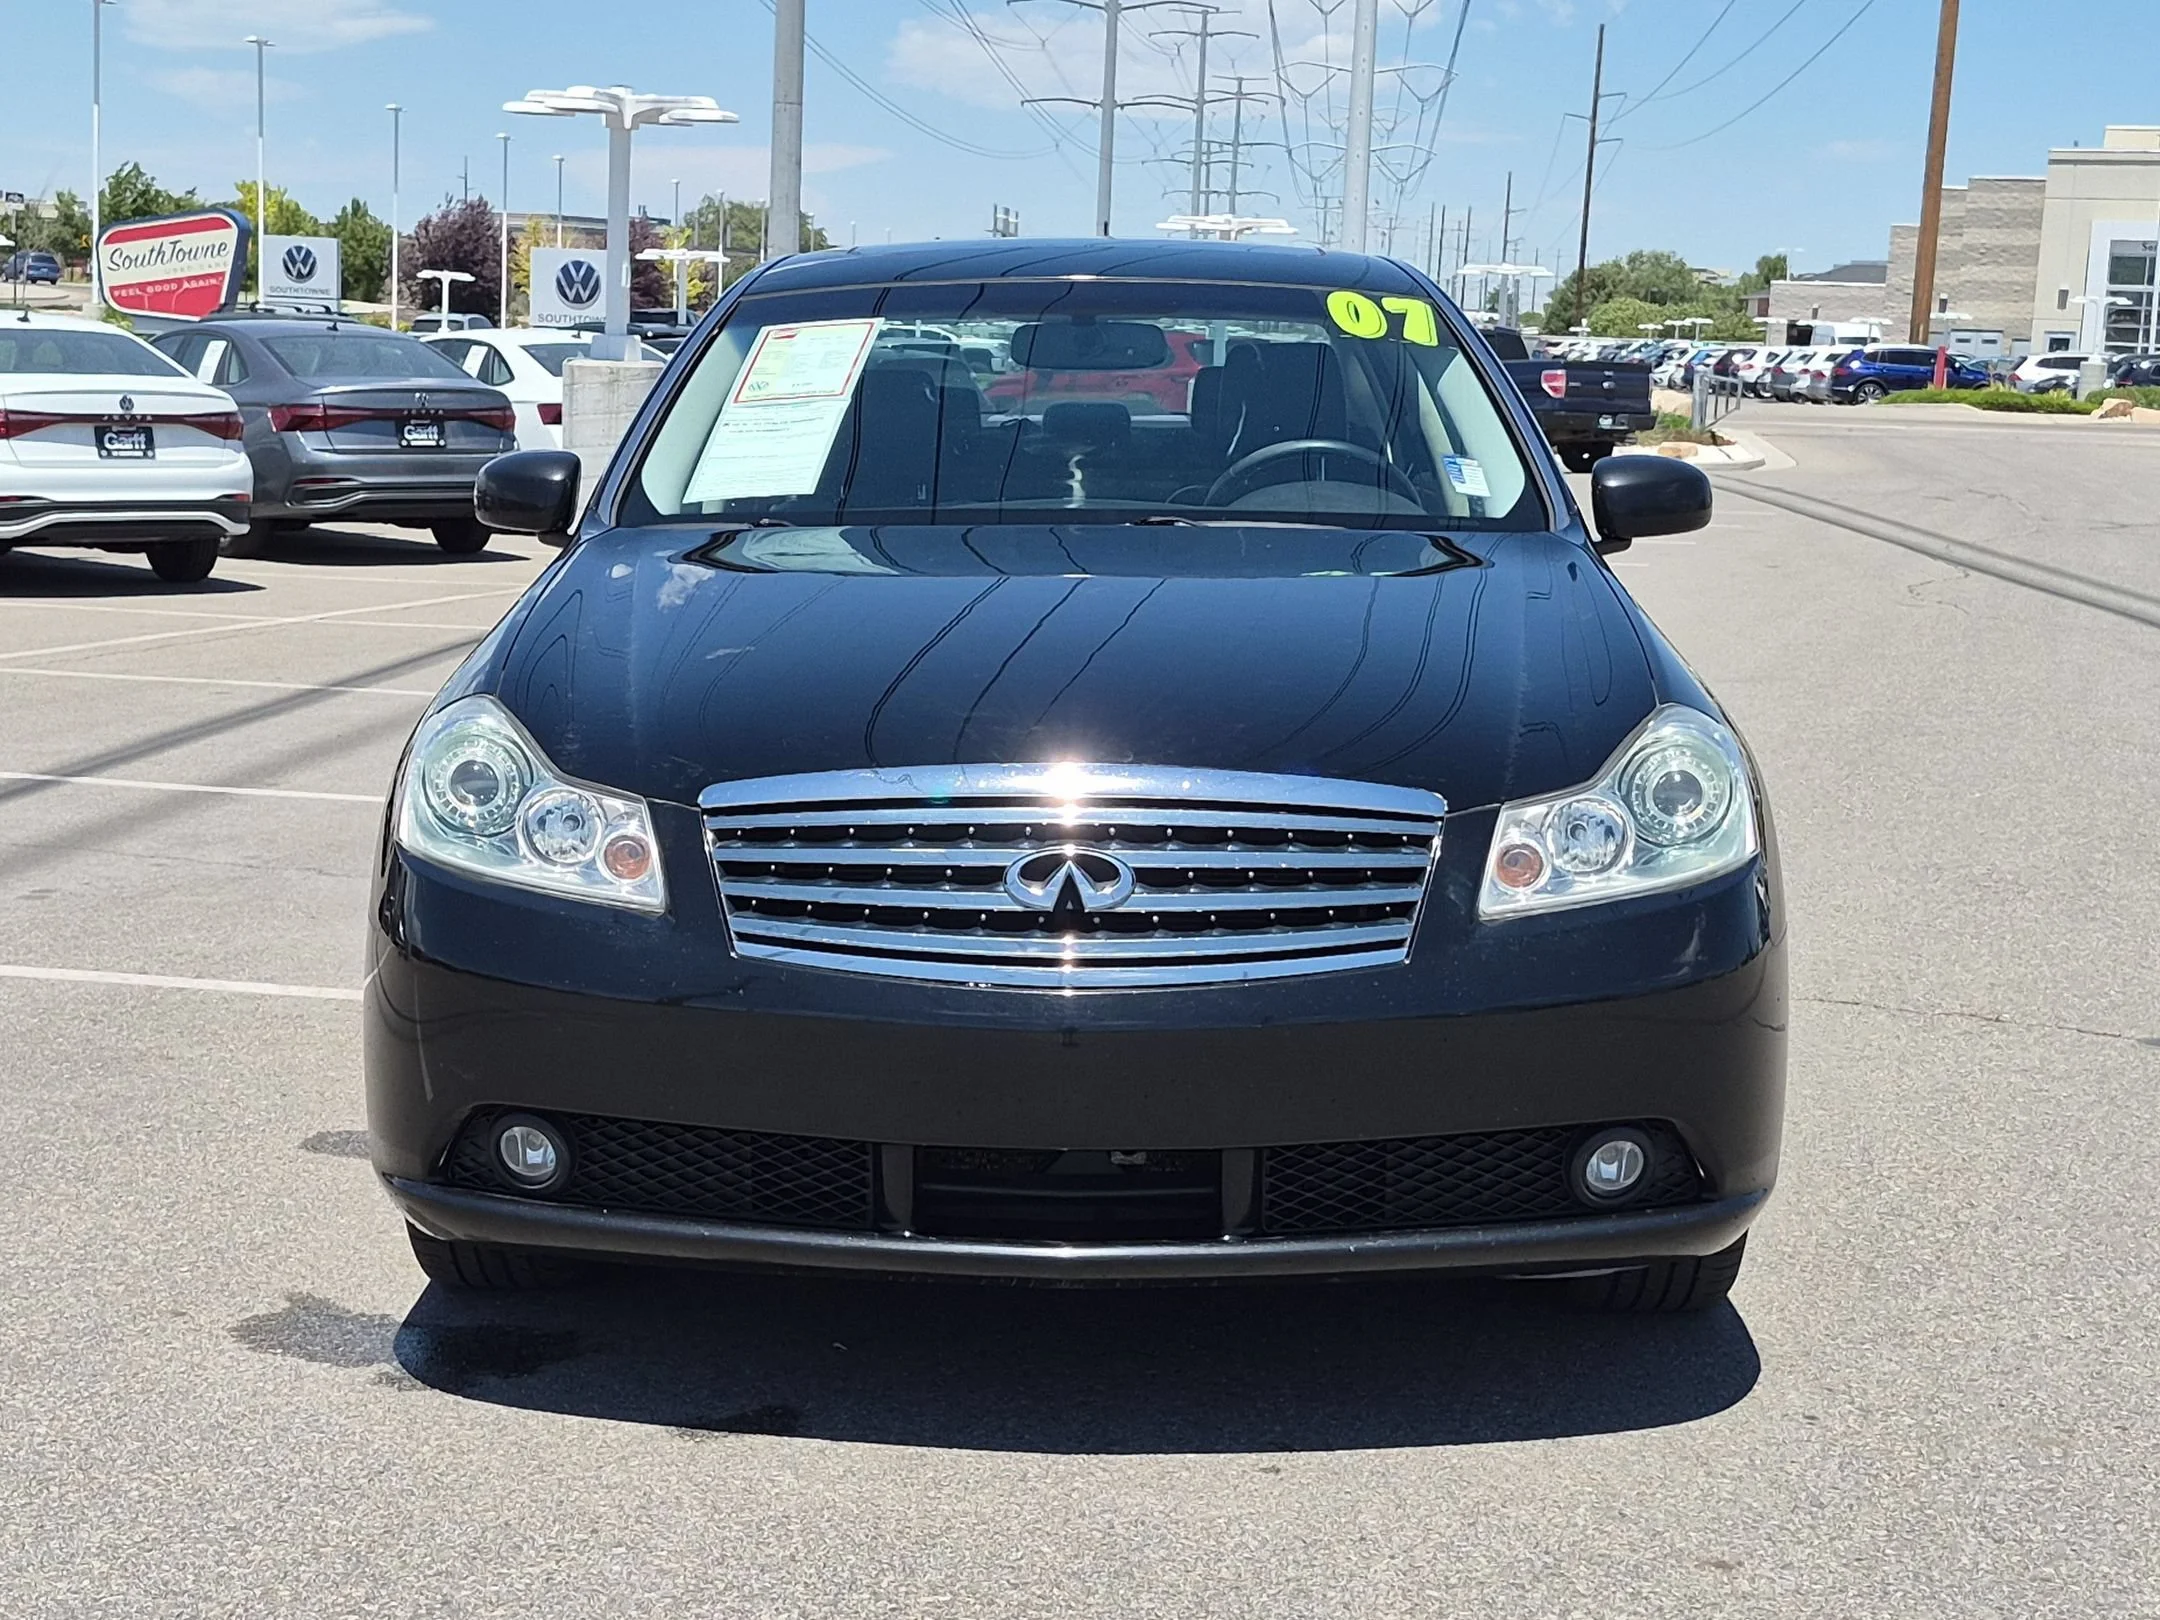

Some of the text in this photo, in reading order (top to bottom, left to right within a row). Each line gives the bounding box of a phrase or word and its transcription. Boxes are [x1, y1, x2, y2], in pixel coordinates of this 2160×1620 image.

[107, 239, 230, 272] SouthTowne
[146, 283, 178, 294] GOOD
[269, 286, 331, 296] SOUTHTOWNE
[1326, 290, 1439, 347] 07
